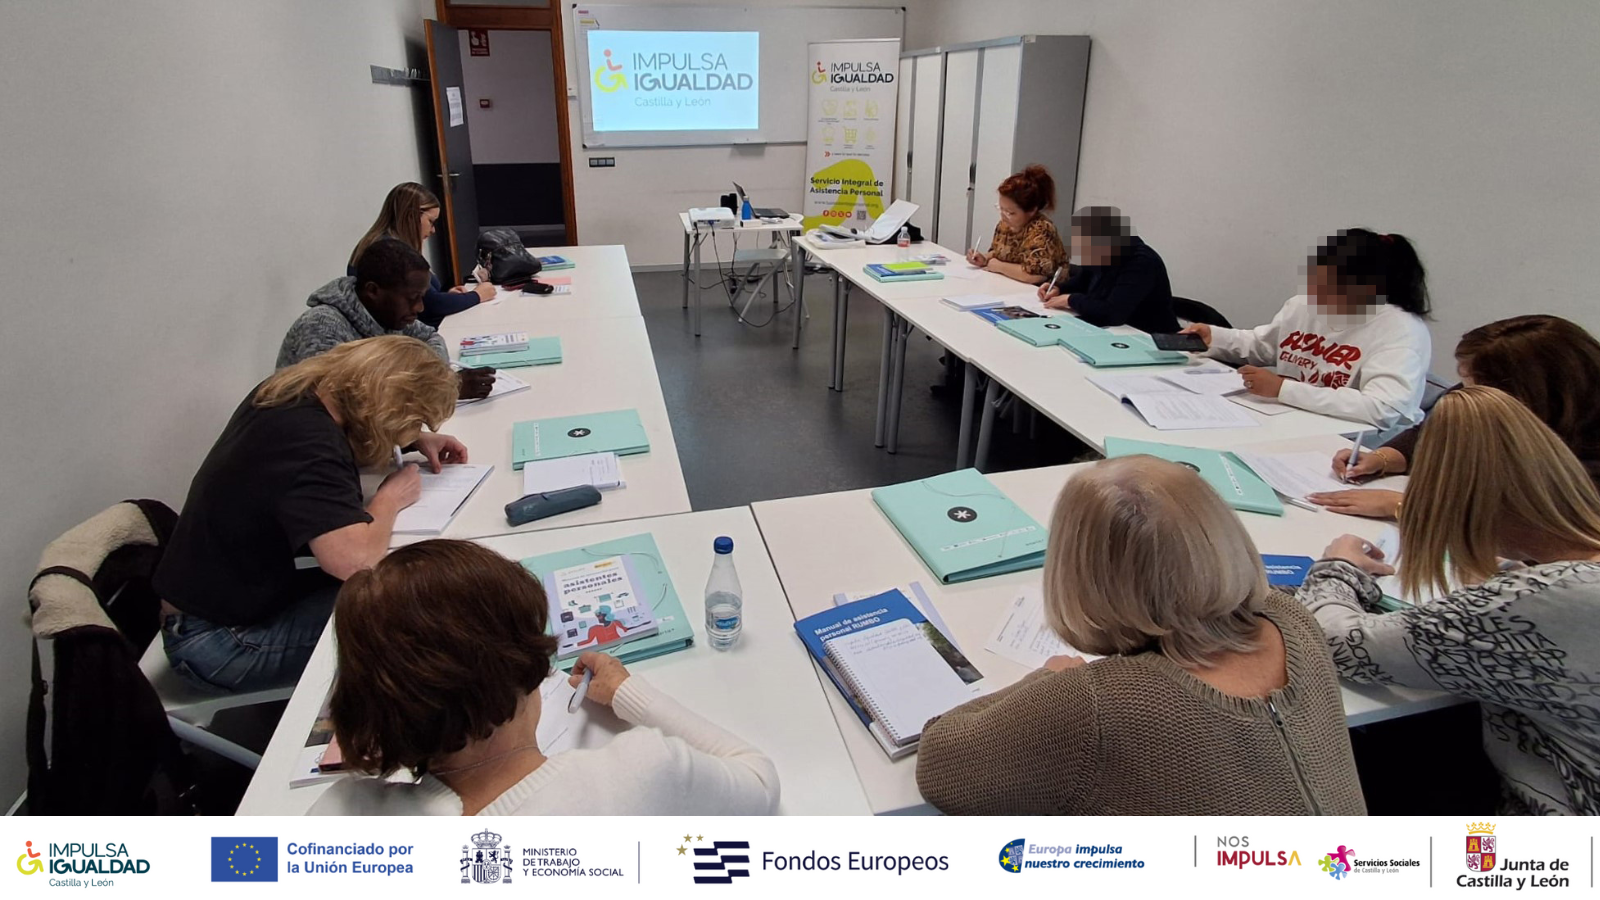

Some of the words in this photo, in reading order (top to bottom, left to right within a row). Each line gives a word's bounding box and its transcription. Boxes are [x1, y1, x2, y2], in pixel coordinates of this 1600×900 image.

[633, 53, 728, 71] IMPULSA
[830, 62, 881, 73] IMPULSA
[634, 73, 753, 91] IGUALDAD
[830, 73, 894, 84] IGUALDAD
[856, 85, 871, 93] León
[634, 96, 673, 107] Castilla
[675, 99, 682, 109] y
[685, 96, 711, 107] León
[810, 177, 841, 186] Servicio
[842, 178, 873, 188] Integral
[873, 179, 884, 187] de
[809, 187, 849, 195] Asistencia
[850, 188, 884, 197] Personal
[1279, 351, 1318, 370] DELIVERY
[563, 572, 618, 588] asistentes
[564, 577, 623, 595] personales
[814, 621, 842, 636] Manual
[842, 617, 853, 627] de
[853, 607, 889, 623] asistencia
[819, 625, 853, 643] personal
[851, 617, 881, 633] RUMBO
